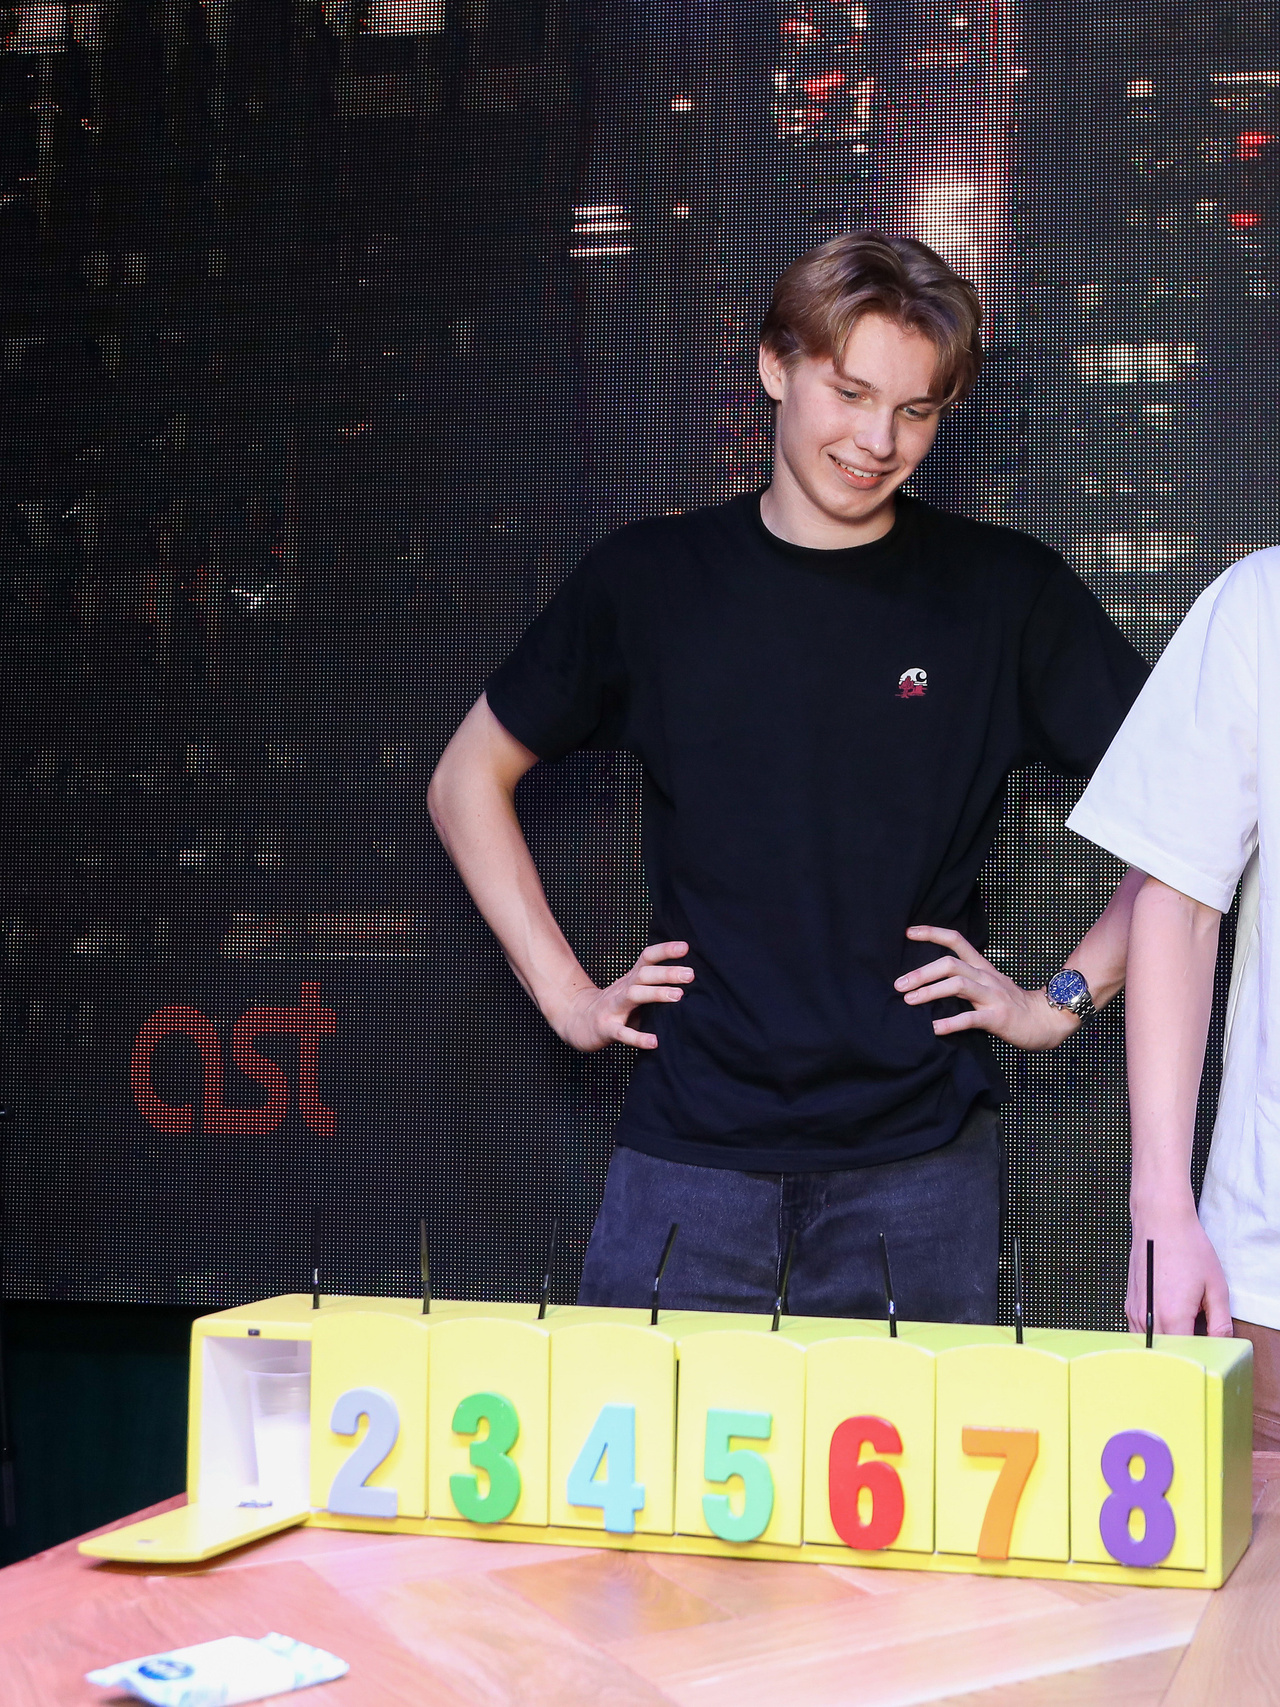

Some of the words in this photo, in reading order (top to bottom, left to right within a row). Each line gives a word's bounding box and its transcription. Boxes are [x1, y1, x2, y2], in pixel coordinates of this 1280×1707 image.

[329, 1388, 399, 1518] 2
[449, 1392, 521, 1524] 3
[567, 1404, 645, 1533] 4
[702, 1409, 774, 1543] 5
[828, 1415, 904, 1551] 6
[961, 1426, 1039, 1560] 7
[1099, 1430, 1176, 1568] 8
